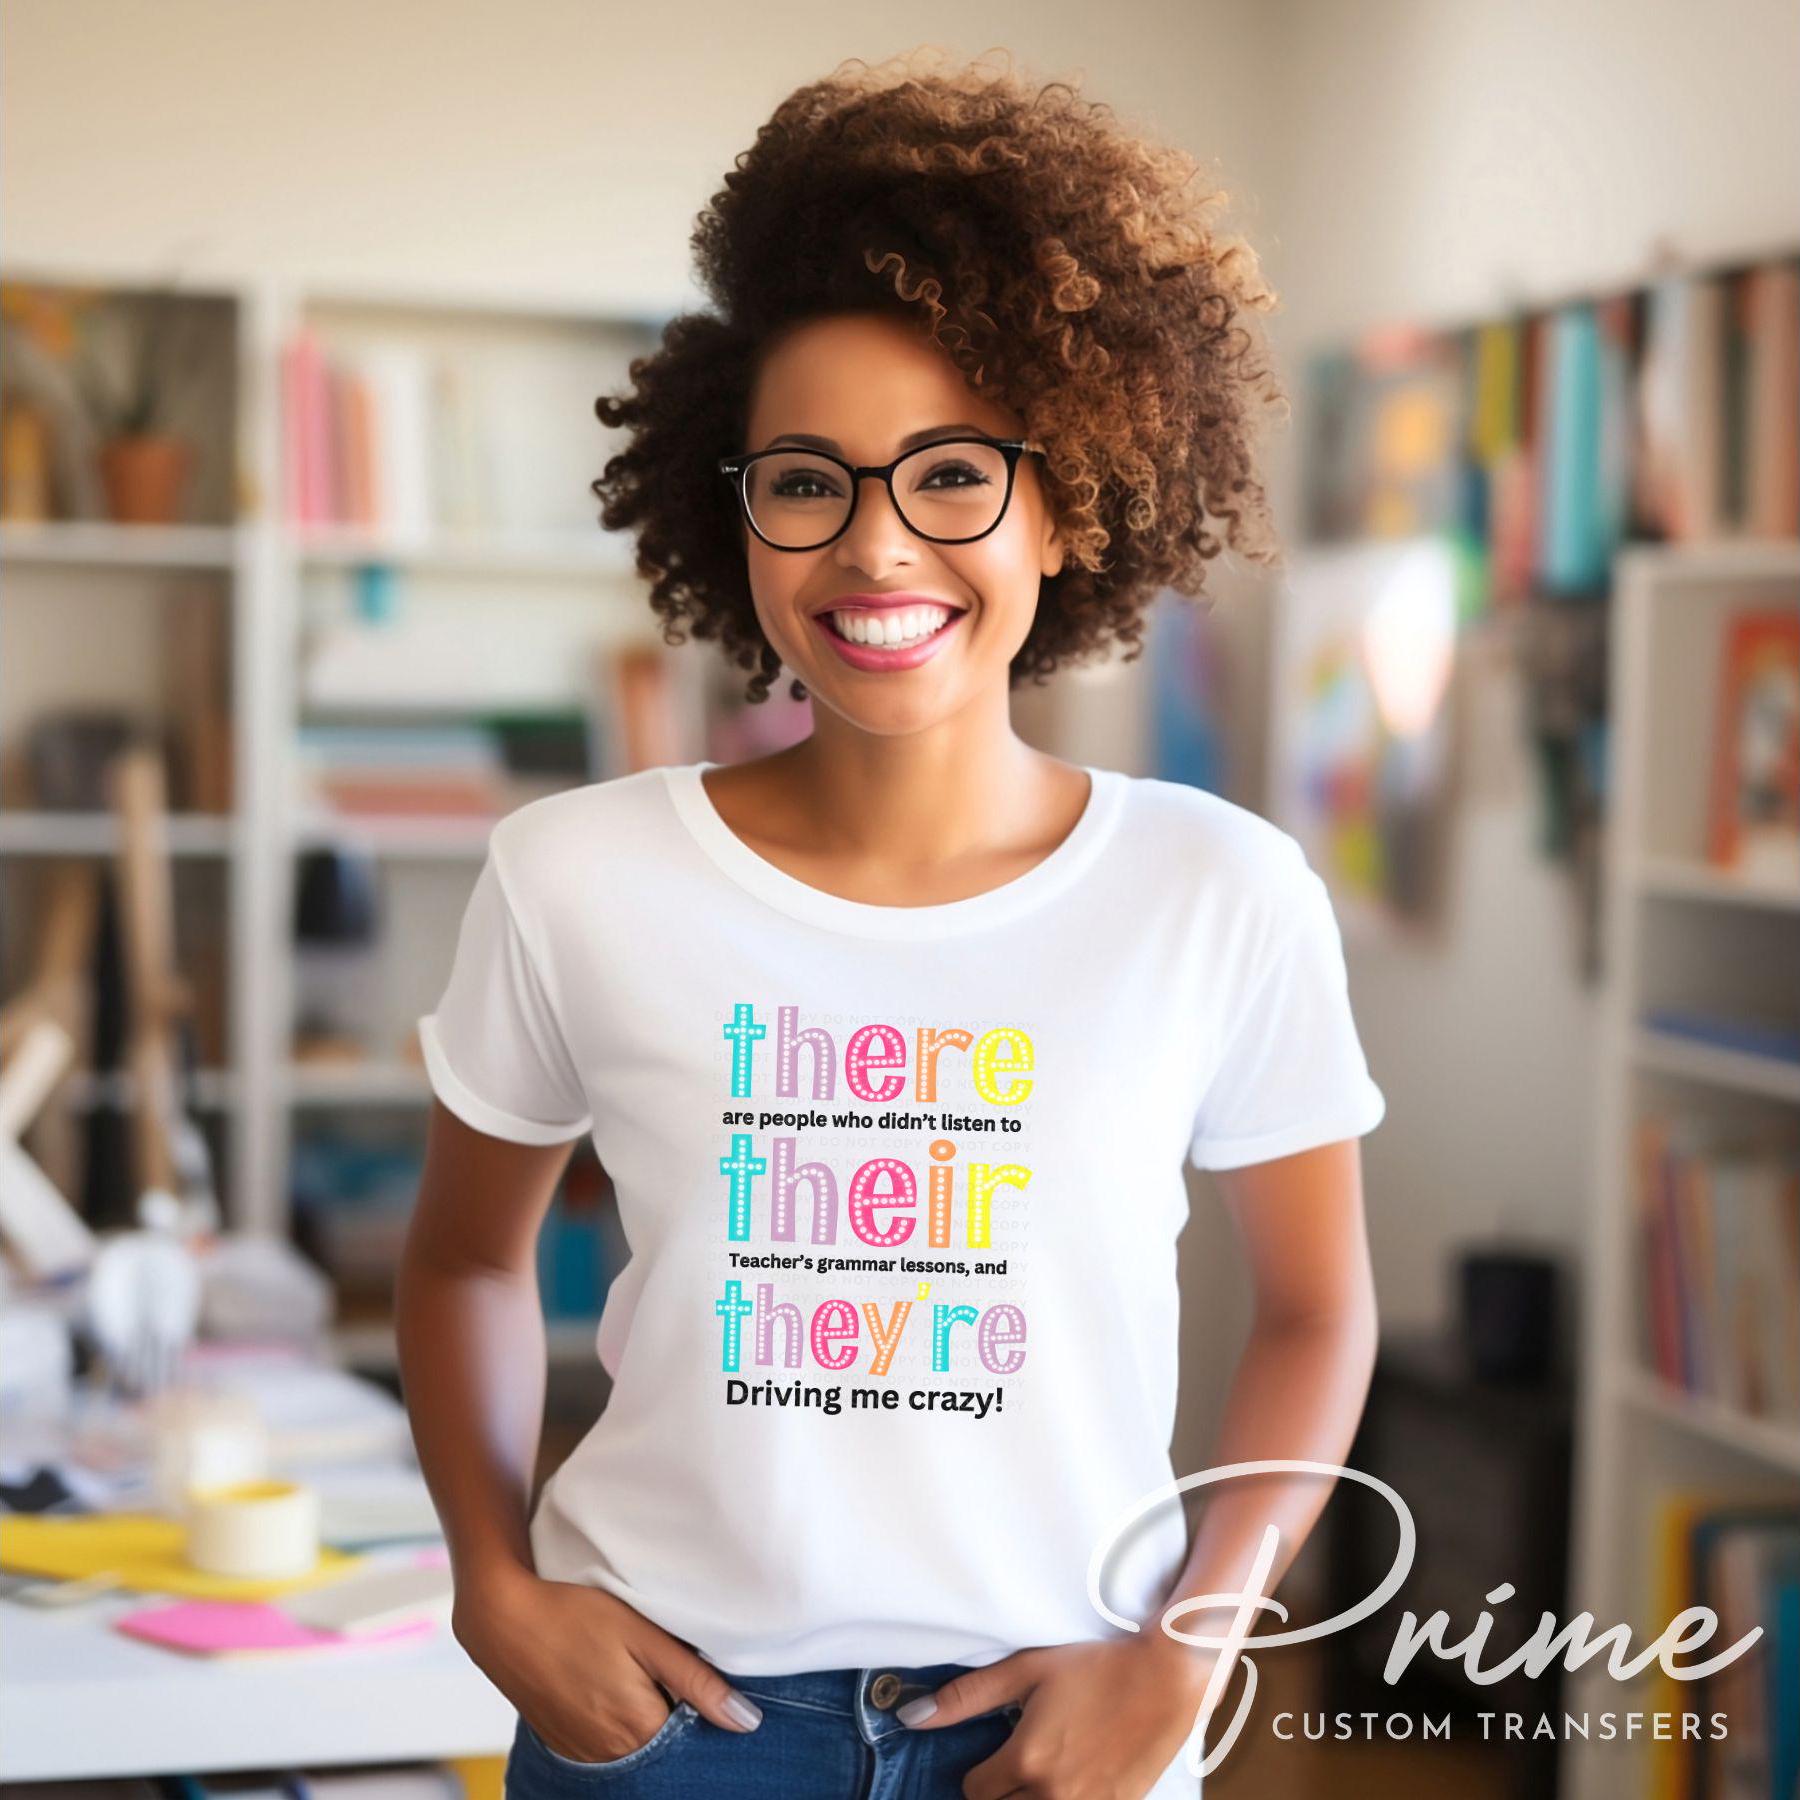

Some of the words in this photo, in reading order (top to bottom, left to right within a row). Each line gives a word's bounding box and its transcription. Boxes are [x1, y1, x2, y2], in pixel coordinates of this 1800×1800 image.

[722, 1003, 1036, 1106] there
[722, 1111, 755, 1126] are
[760, 1109, 828, 1131] people
[832, 1110, 874, 1129] who
[878, 1112, 937, 1131] didn't
[941, 1113, 996, 1132] listen
[1000, 1117, 1022, 1133] to
[719, 1132, 1034, 1249] their
[729, 1252, 814, 1270] Teacher's
[817, 1257, 897, 1274] grammar
[900, 1256, 971, 1276] lessons,
[974, 1259, 1008, 1275] and
[714, 1279, 1028, 1376] they're
[726, 1379, 842, 1416] Driving
[851, 1388, 900, 1411] me
[908, 1387, 1004, 1420] crazy!
